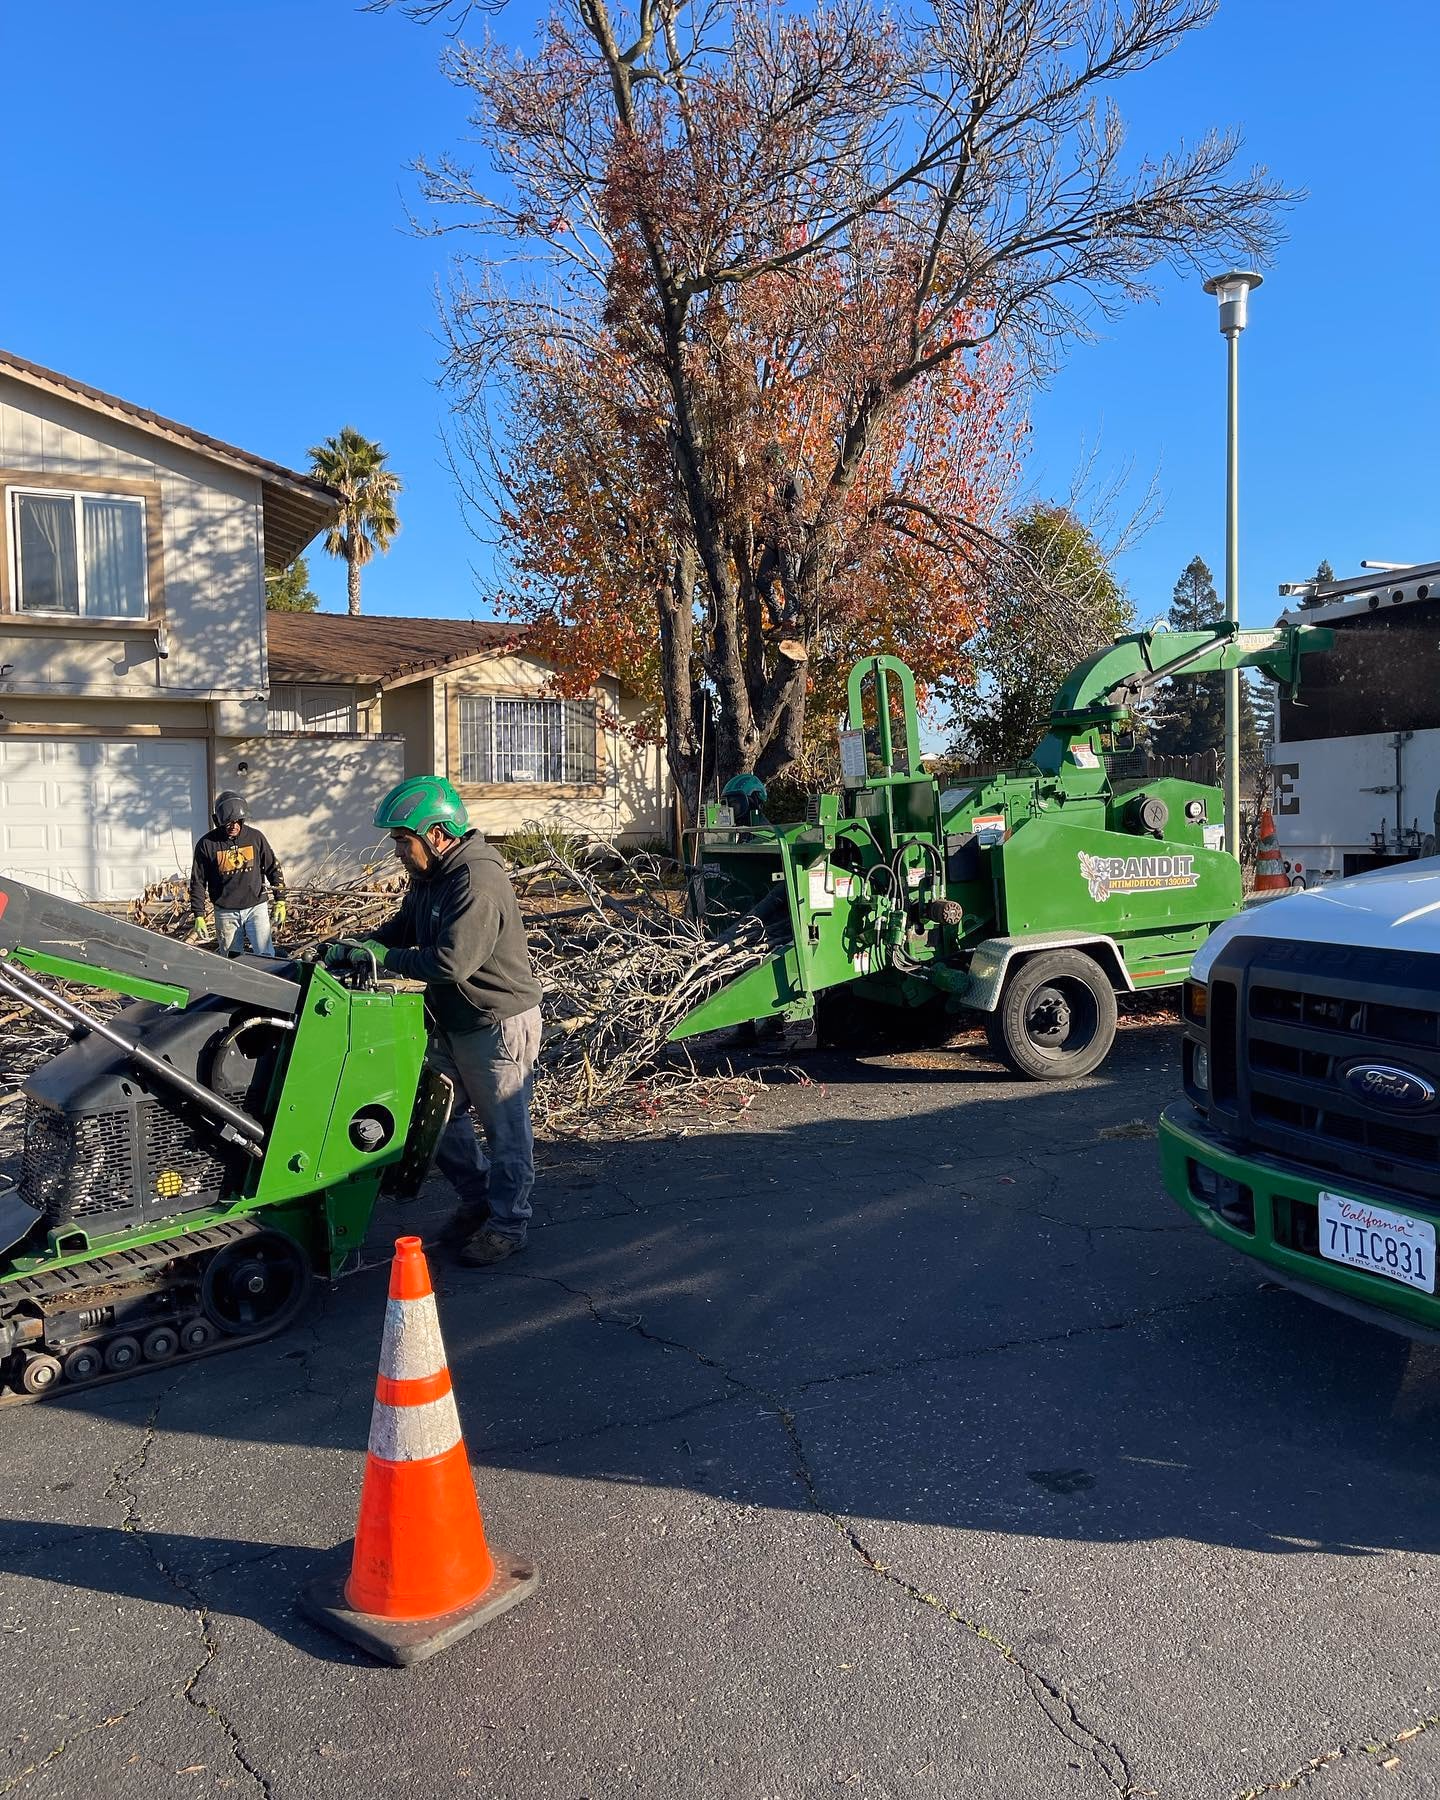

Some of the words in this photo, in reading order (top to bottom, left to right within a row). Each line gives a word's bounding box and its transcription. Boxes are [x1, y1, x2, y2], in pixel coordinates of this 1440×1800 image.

[1109, 856, 1193, 878] BANDIT
[1361, 1070, 1409, 1098] Ford
[1341, 1203, 1413, 1238] California
[1326, 1218, 1427, 1281] 7TIC831
